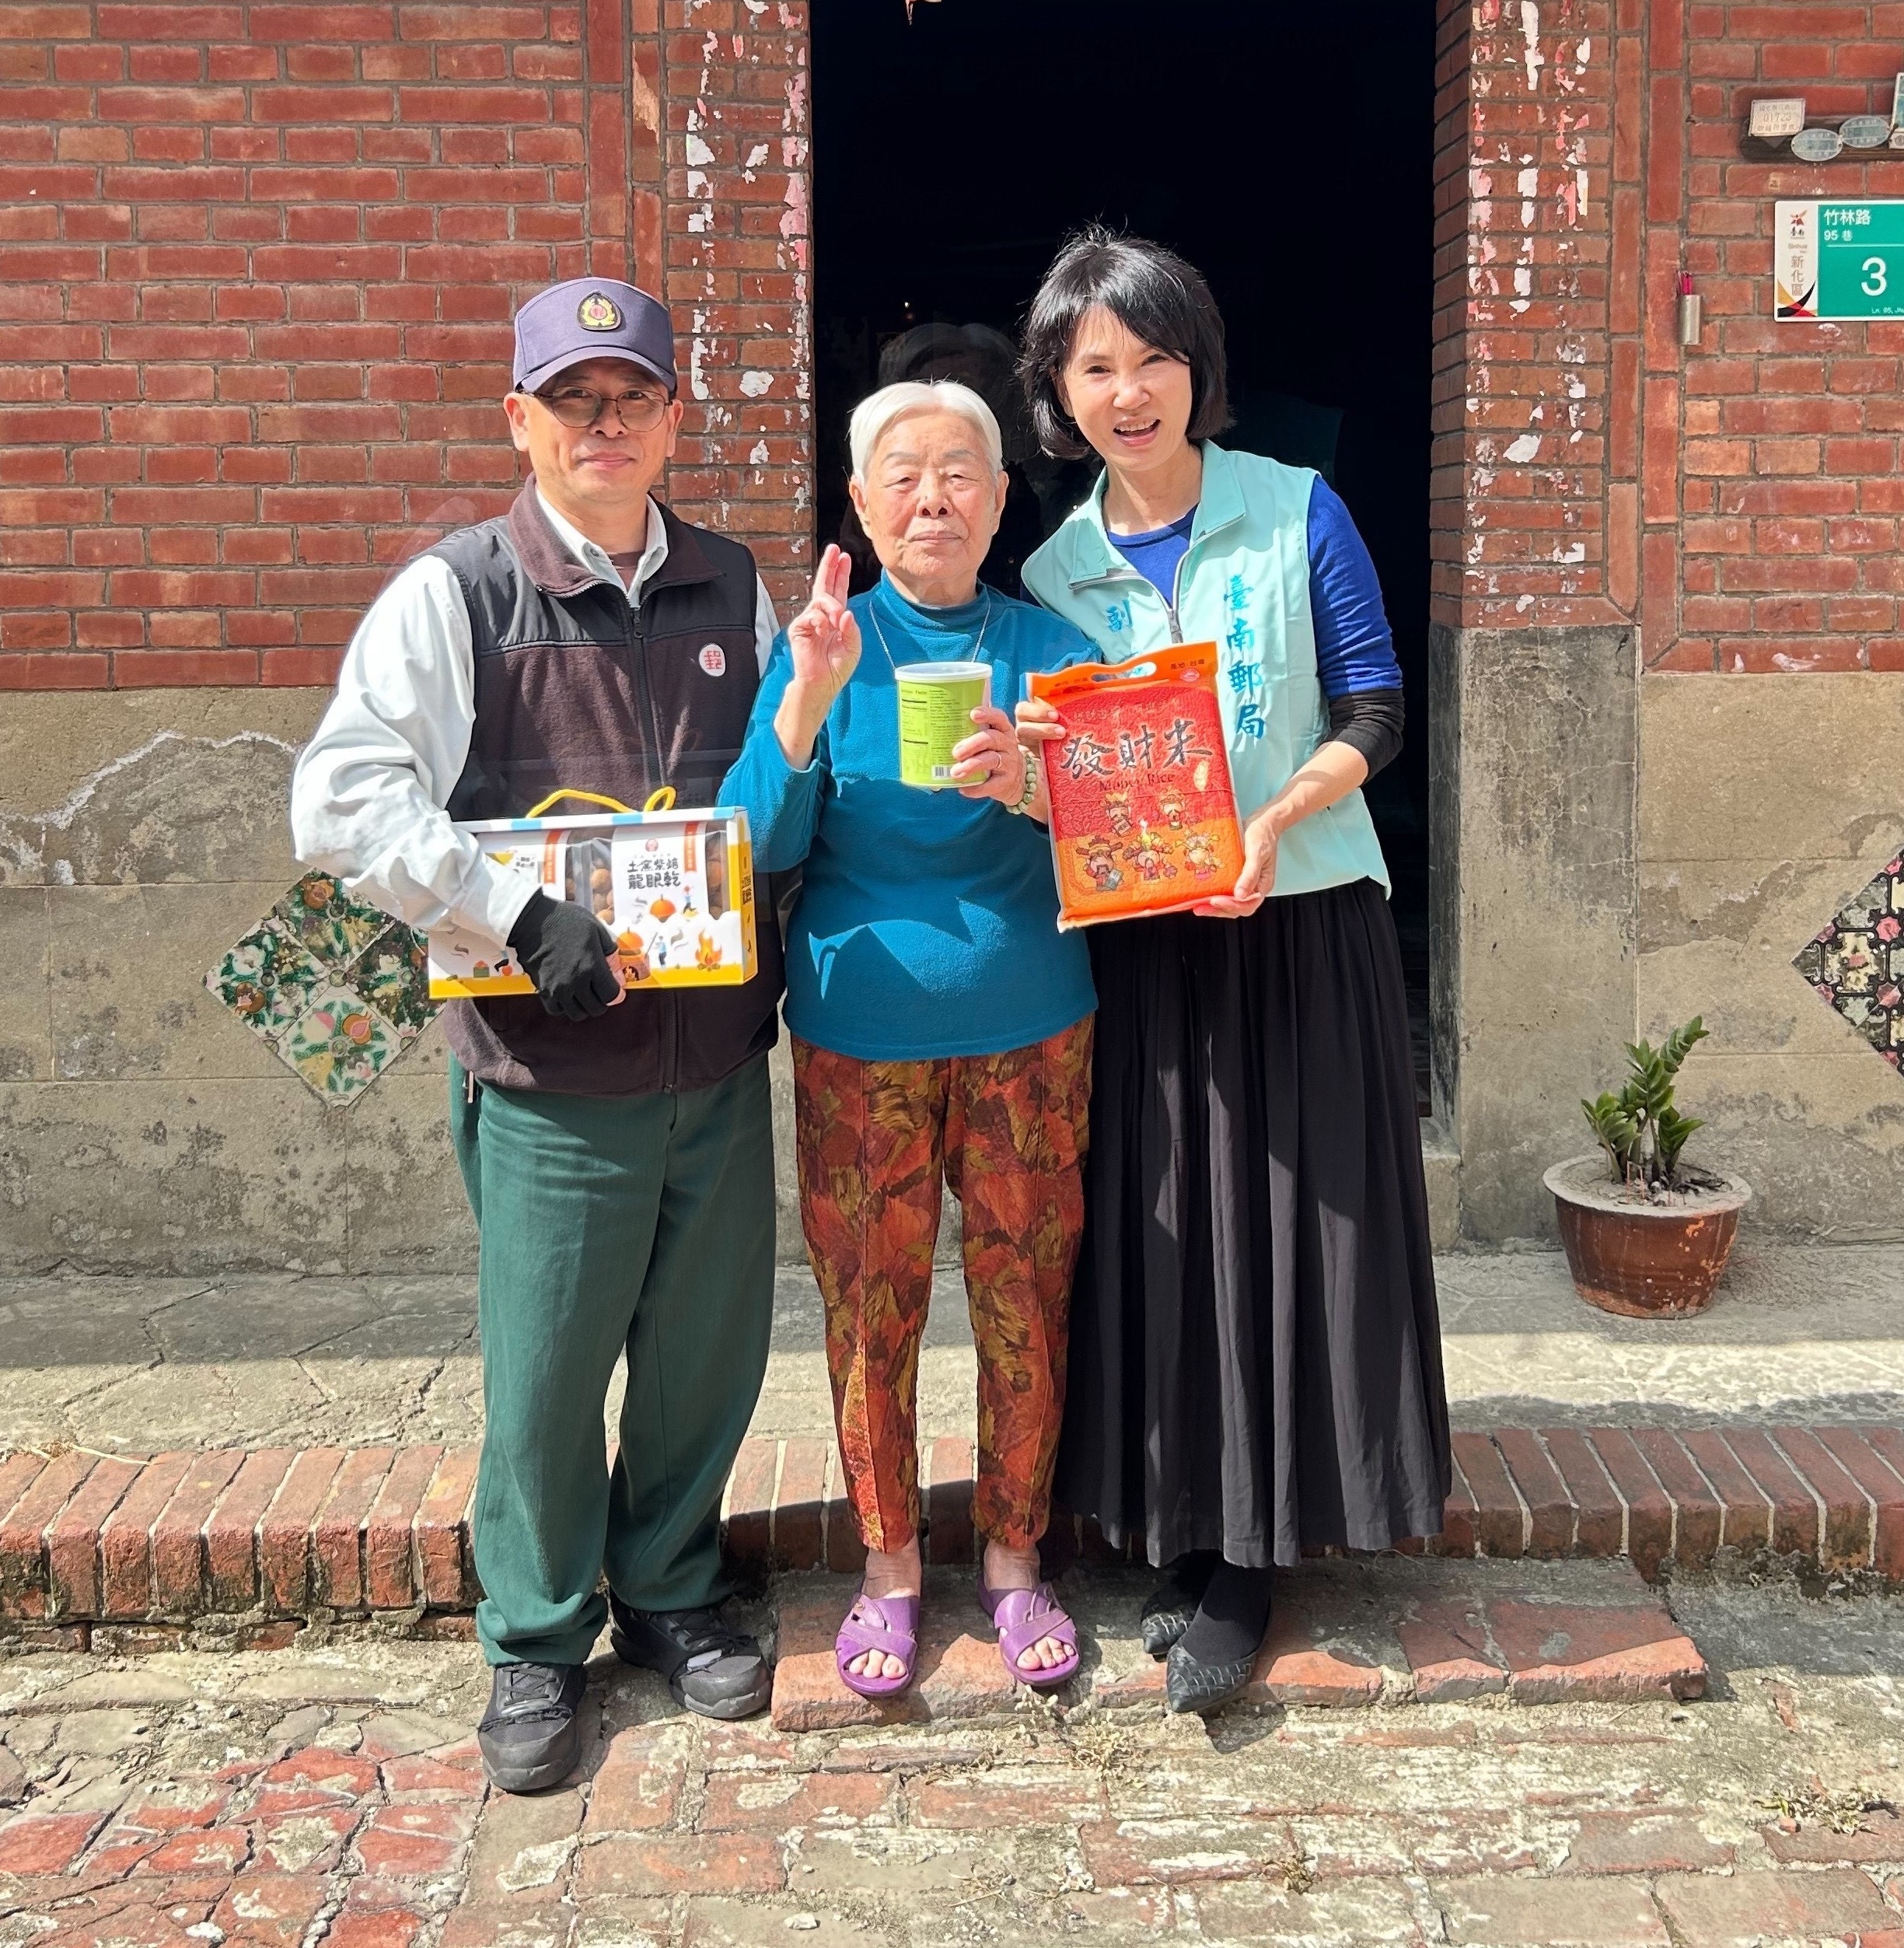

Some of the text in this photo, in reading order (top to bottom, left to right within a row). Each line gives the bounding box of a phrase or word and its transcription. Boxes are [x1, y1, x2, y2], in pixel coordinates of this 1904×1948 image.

[1824, 209, 1871, 226] 竹林路
[1824, 230, 1853, 241] 95 巷
[1791, 255, 1804, 296] 新化區
[1860, 257, 1888, 296] 3
[1224, 574, 1266, 739] 臺南郵局
[1060, 718, 1213, 780] 發財米
[1147, 773, 1175, 785] Rice
[628, 870, 681, 890] 龍眼乾
